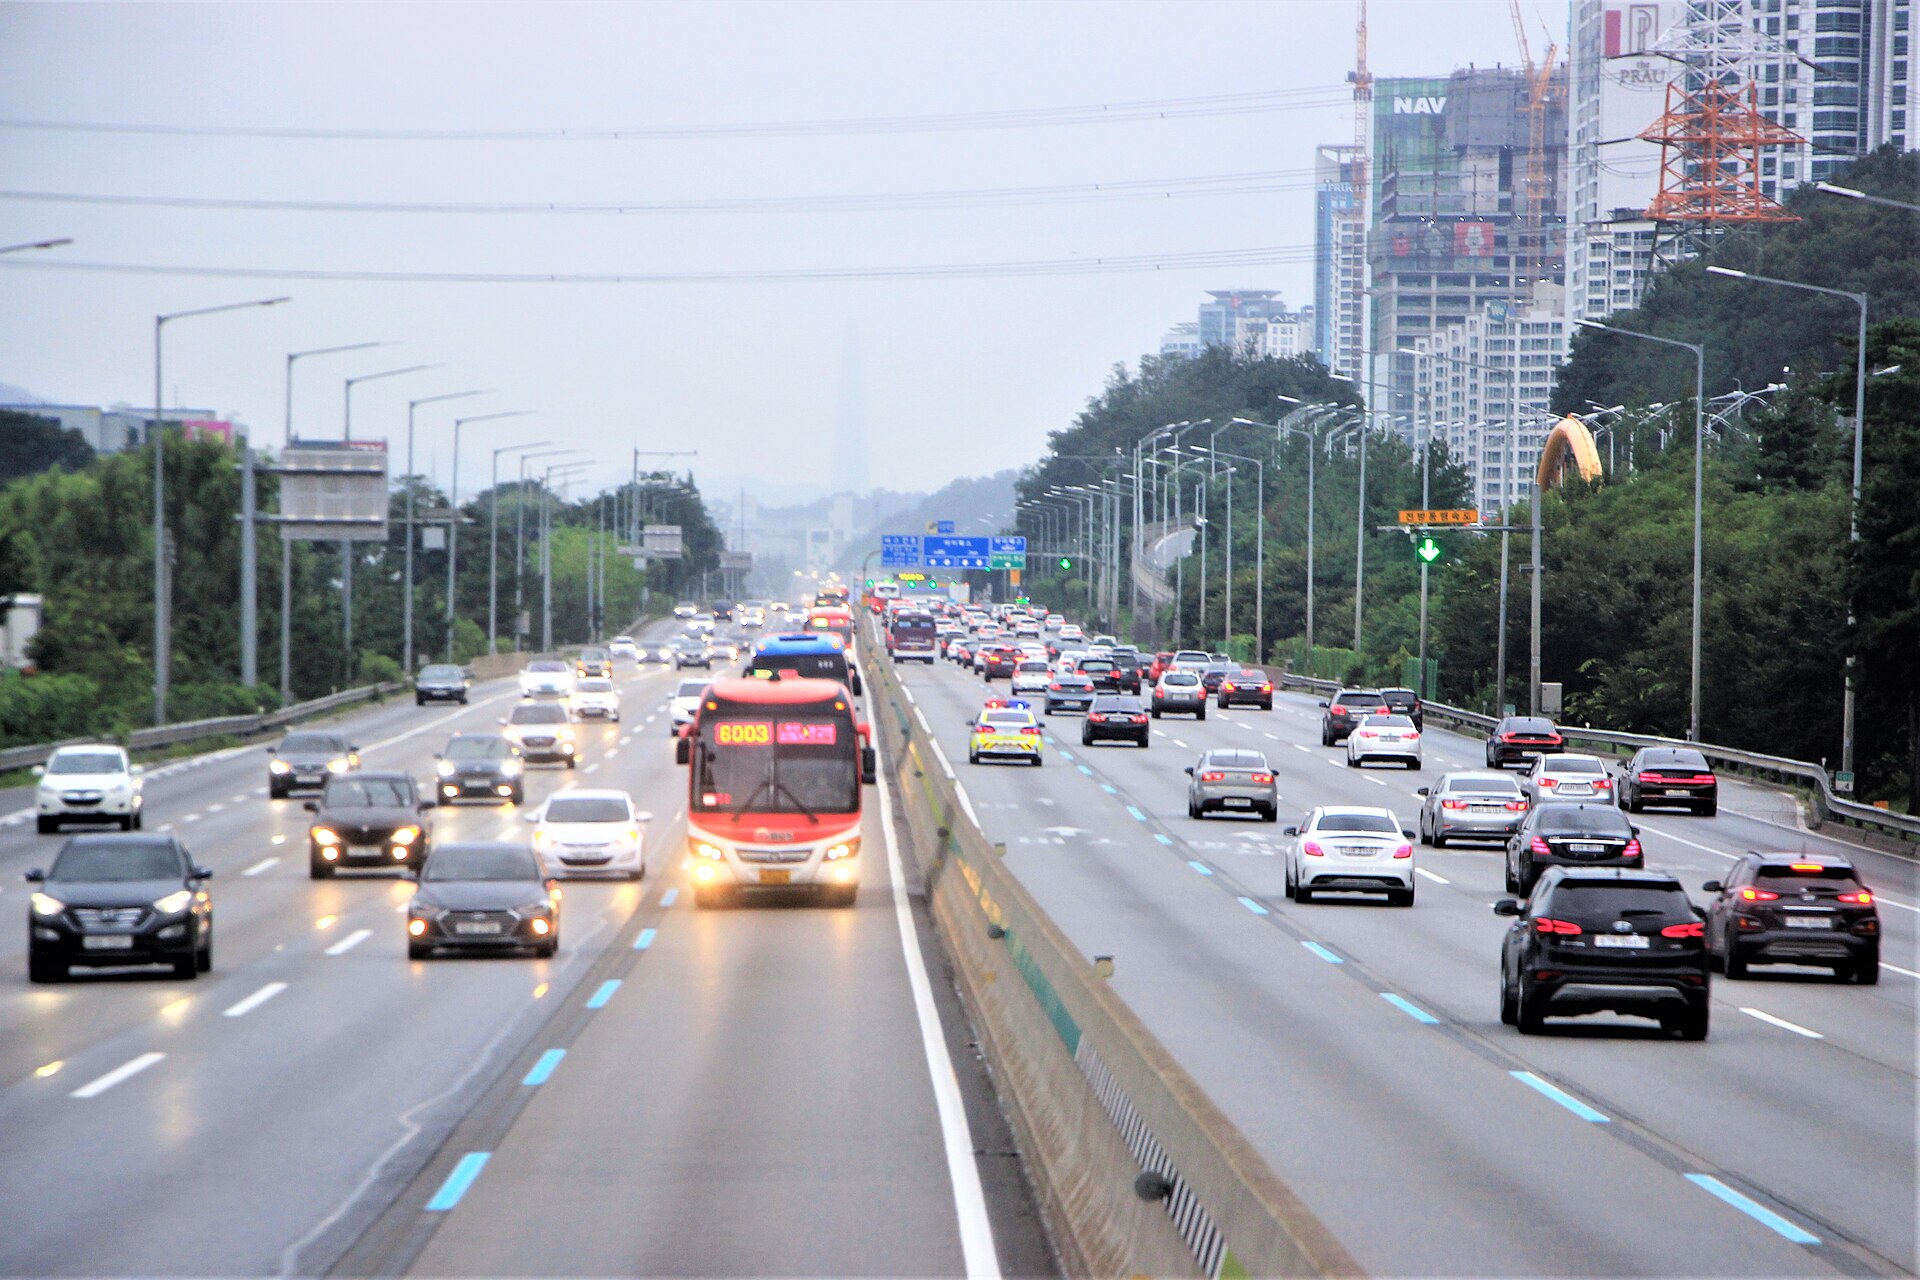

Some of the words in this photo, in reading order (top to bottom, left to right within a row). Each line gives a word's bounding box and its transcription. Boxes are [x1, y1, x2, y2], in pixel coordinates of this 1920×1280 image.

[1636, 60, 1650, 69] the
[1619, 69, 1666, 83] PRAU
[1393, 96, 1447, 115] NAV
[719, 724, 769, 744] 6003
